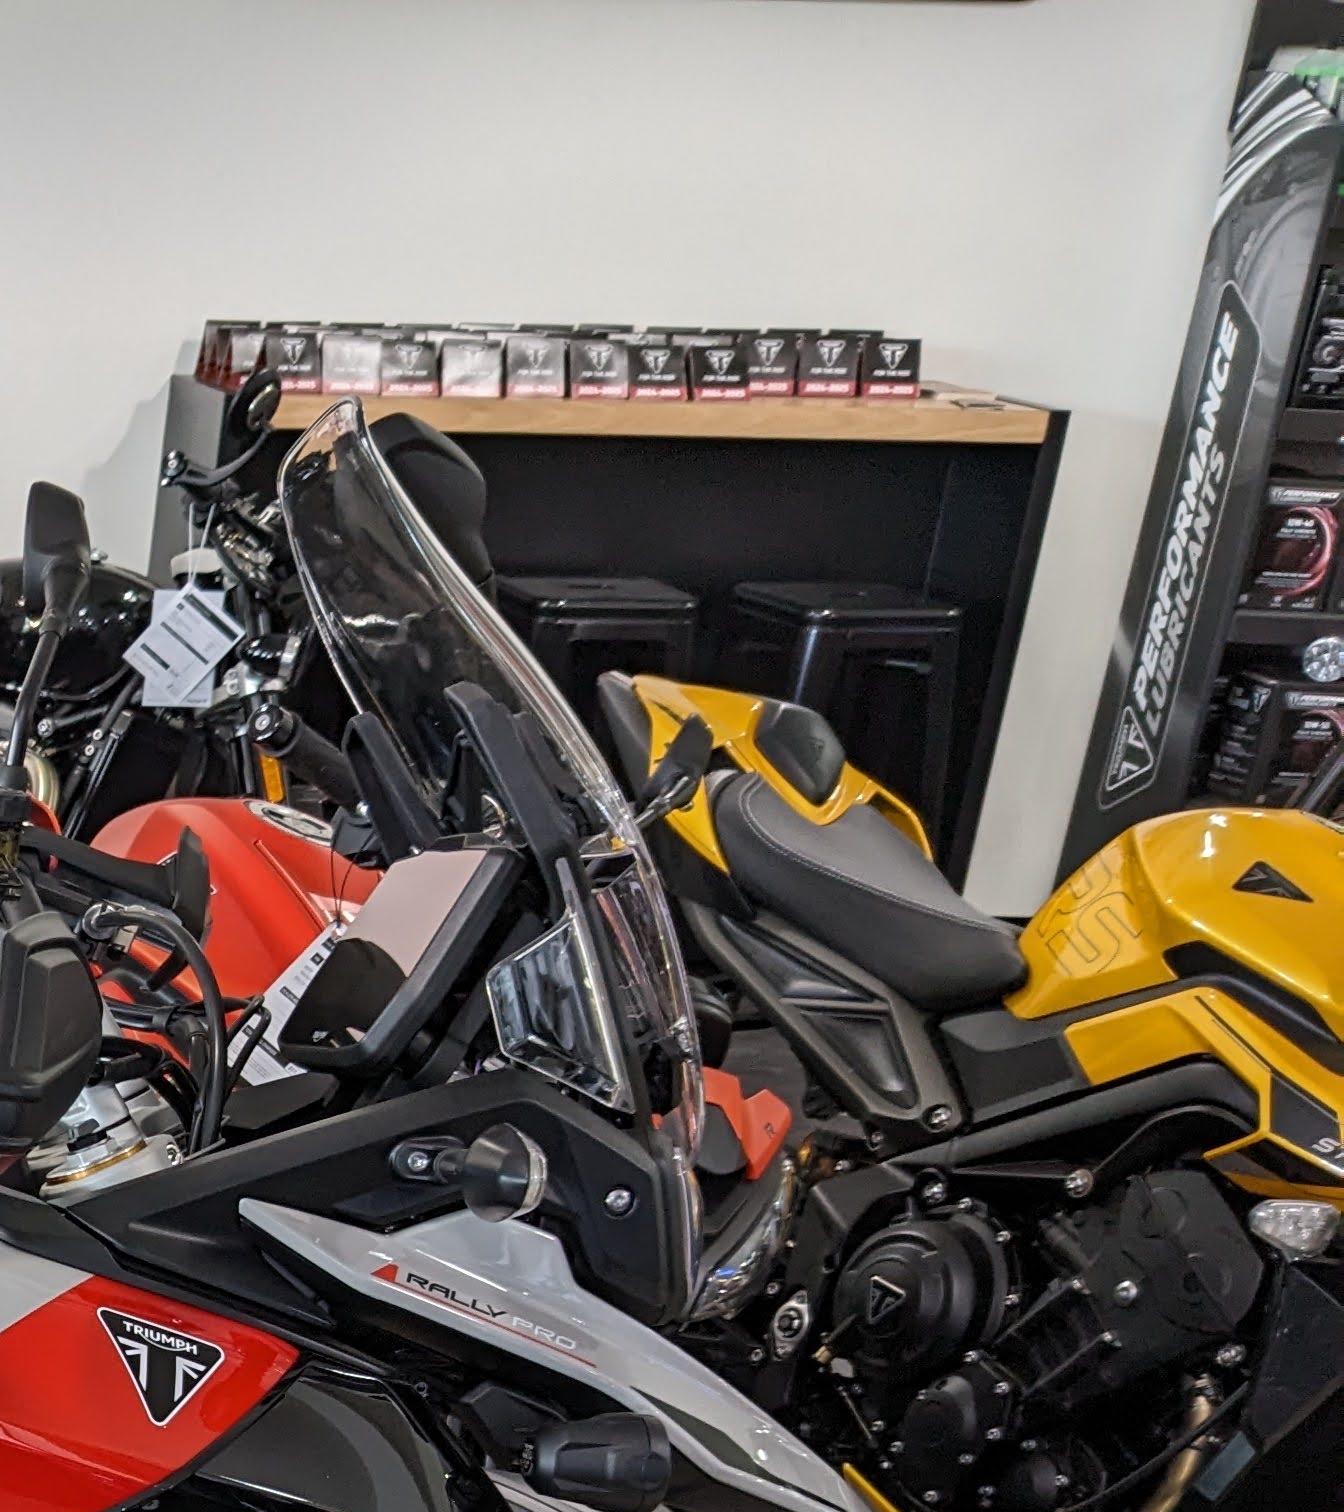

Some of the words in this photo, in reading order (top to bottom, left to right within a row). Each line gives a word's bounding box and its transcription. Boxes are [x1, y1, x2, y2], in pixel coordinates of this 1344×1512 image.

[1132, 311, 1239, 707] PERFORMANCE
[1146, 448, 1225, 737] LUBRICANTS
[122, 1320, 198, 1356] TRIUMPH
[406, 1272, 508, 1319] RALLY
[512, 1316, 577, 1351] PRO
